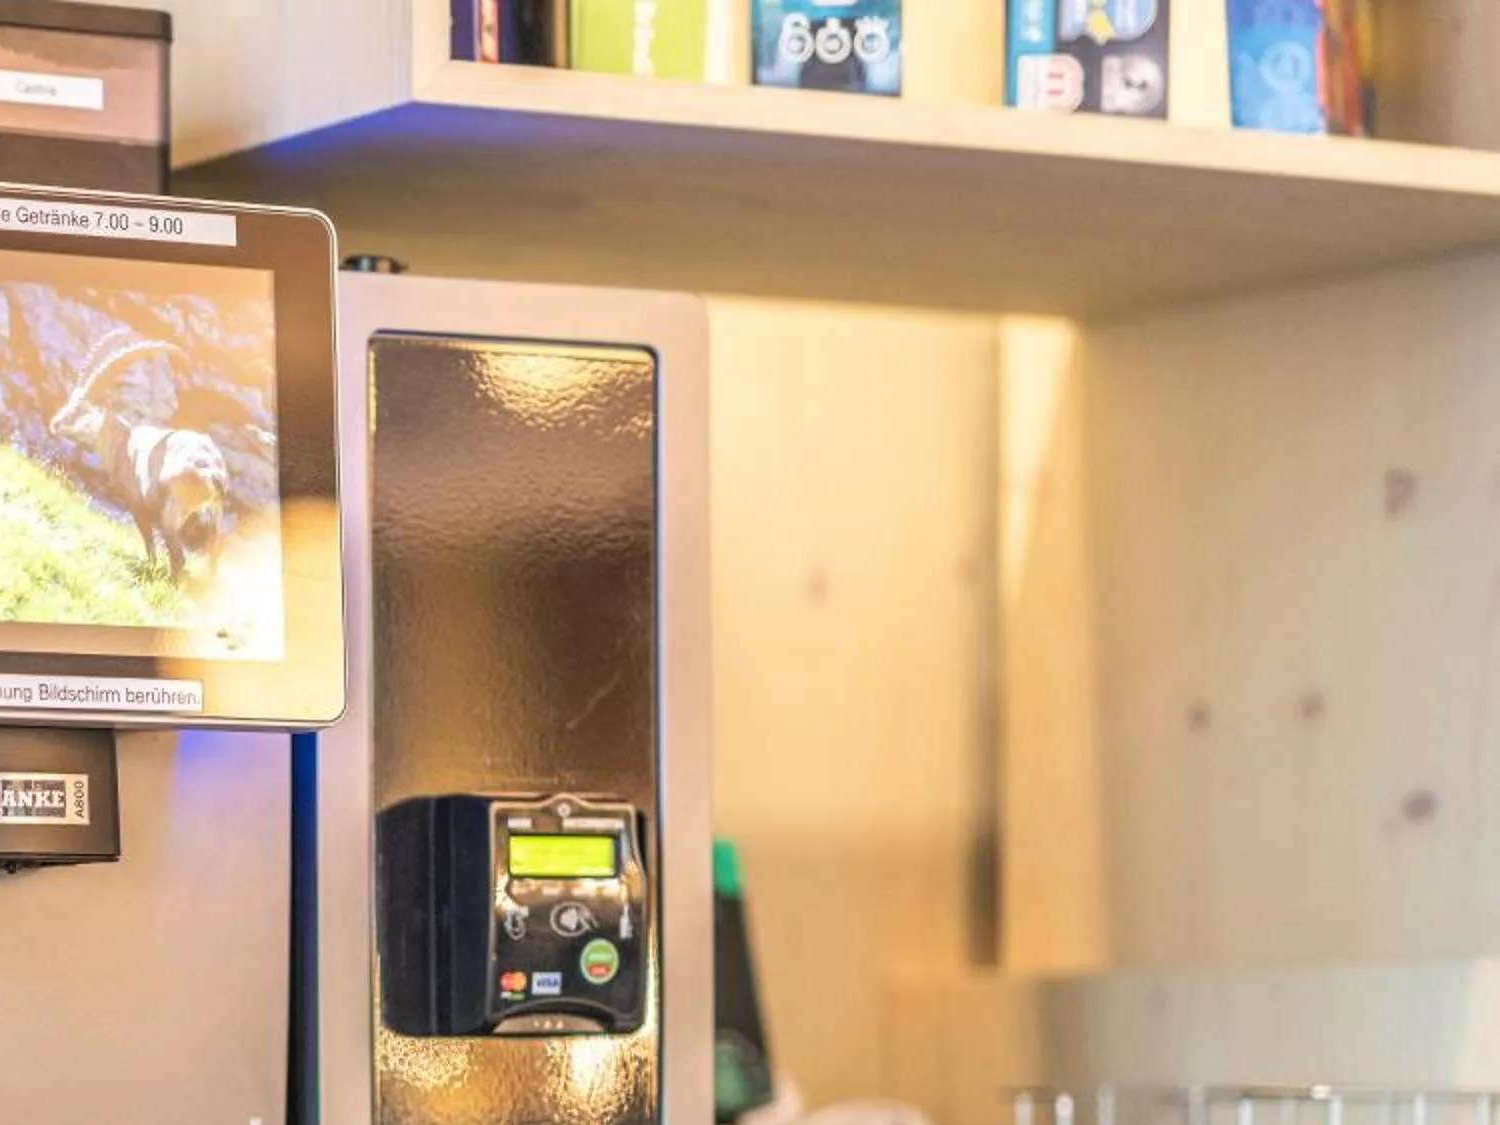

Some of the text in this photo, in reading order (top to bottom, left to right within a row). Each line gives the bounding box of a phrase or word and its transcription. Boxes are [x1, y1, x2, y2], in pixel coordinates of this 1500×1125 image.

[15, 206, 90, 229] Getränke
[94, 211, 129, 231] 7.00
[149, 215, 183, 235] 9.00
[38, 683, 121, 703] Bildschirm
[125, 685, 201, 705] berühren.
[73, 781, 85, 819] A800
